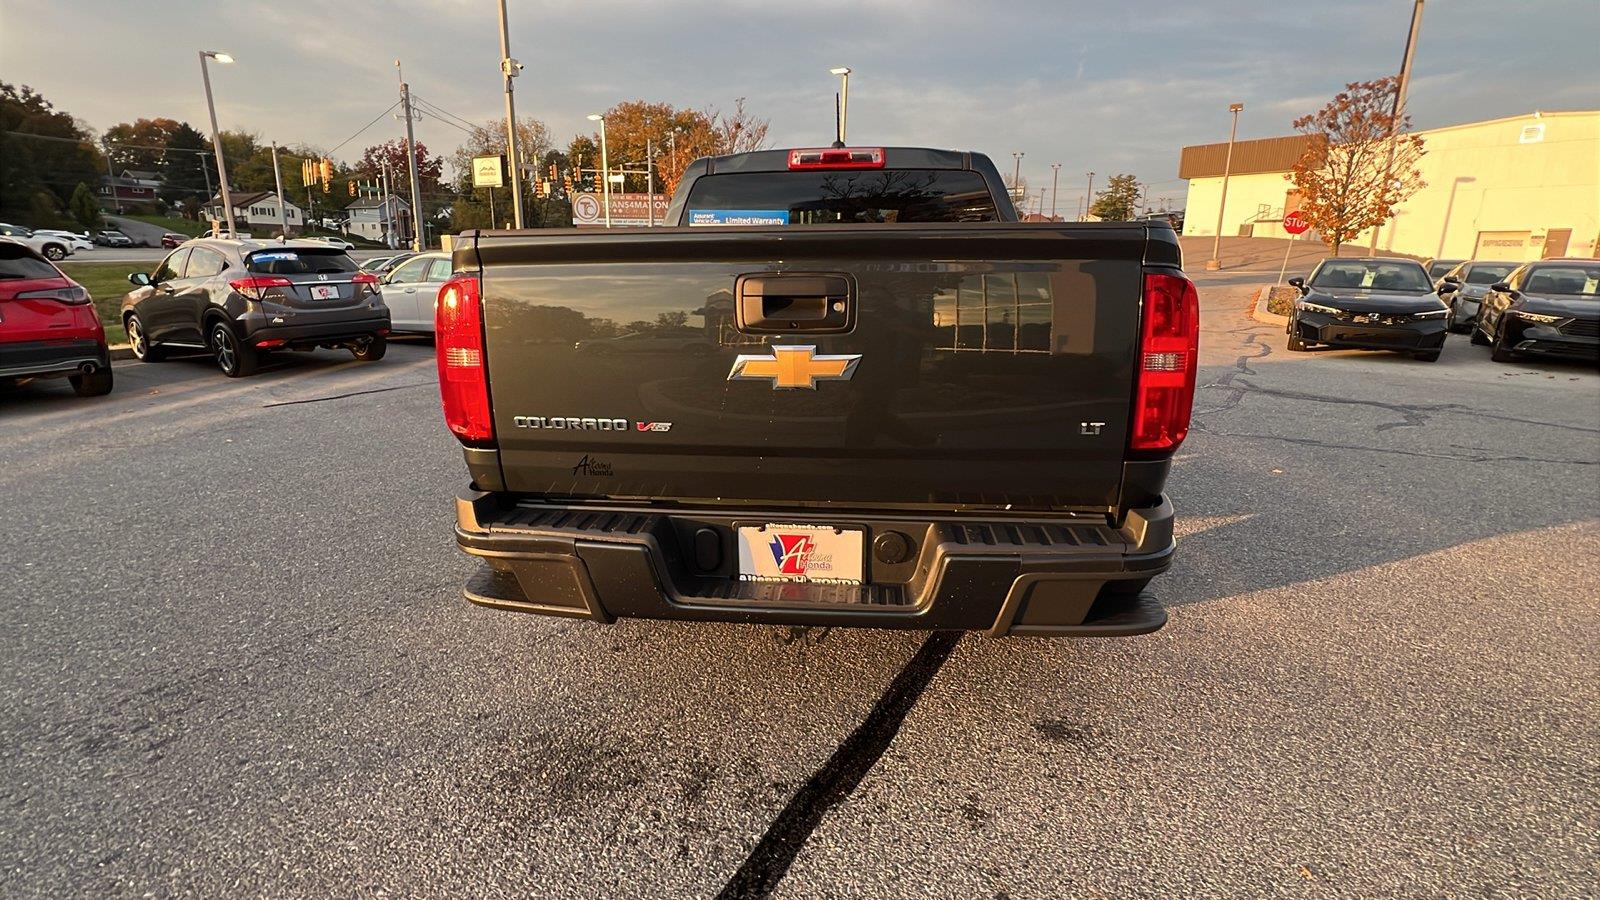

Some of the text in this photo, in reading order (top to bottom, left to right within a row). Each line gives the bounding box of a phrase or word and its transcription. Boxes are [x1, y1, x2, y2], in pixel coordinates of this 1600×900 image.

[602, 201, 668, 209] TANS4MAION
[725, 217, 785, 226] Limited Warranty
[513, 415, 673, 432] COLORADO V6
[1081, 422, 1105, 435] LT
[800, 561, 832, 570] Honda
